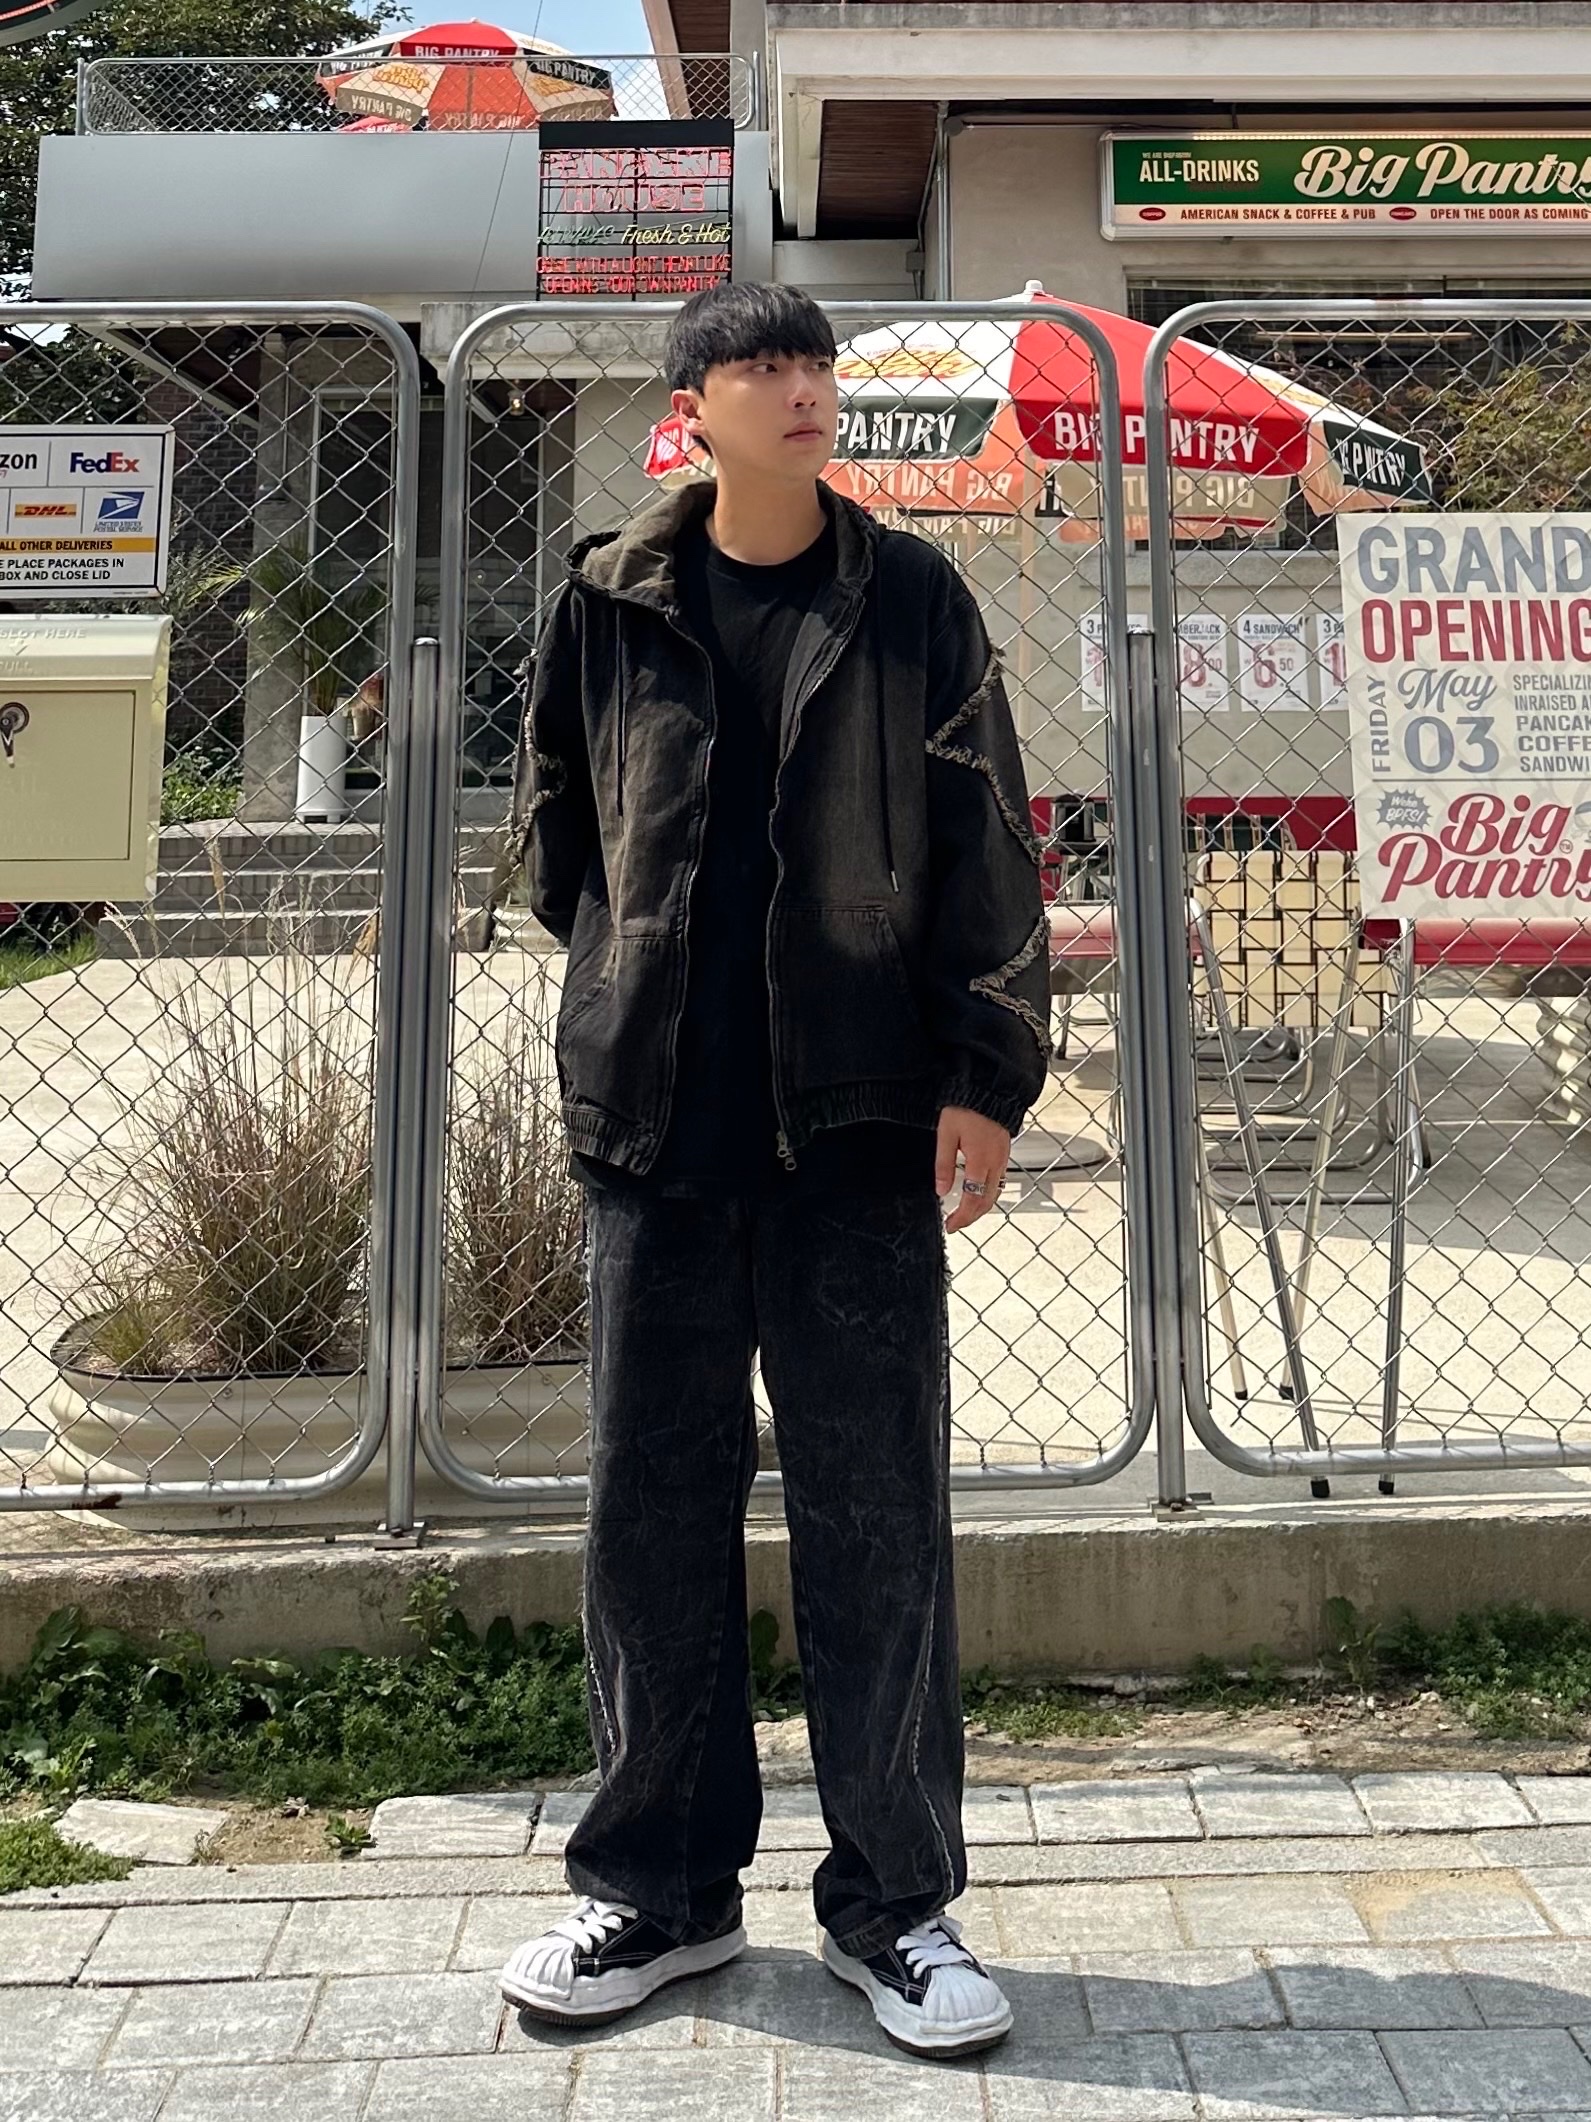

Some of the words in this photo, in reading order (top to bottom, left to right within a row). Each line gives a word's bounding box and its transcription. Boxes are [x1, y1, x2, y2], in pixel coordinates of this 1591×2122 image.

[1139, 159, 1260, 183] ALL-DRINKS
[1293, 144, 1411, 199] Big
[564, 180, 706, 213] HOUSE
[1180, 208, 1239, 220] AMERICAN
[1242, 208, 1280, 220] SNACK
[1283, 208, 1292, 220] &
[1295, 208, 1338, 220] COFFEE
[1341, 208, 1350, 220] &
[1353, 208, 1376, 220] PUB
[1430, 208, 1460, 219] OPEN
[1465, 208, 1485, 219] THE
[1489, 208, 1520, 219] DOOR
[1523, 208, 1539, 219] AS
[1542, 208, 1589, 219] COMING
[621, 224, 674, 244] Fresh
[677, 223, 693, 244] &
[695, 222, 732, 243] Hot
[836, 410, 957, 454] PANTRY
[1124, 414, 1259, 463] PNTRY
[69, 452, 140, 473] FedEx
[23, 506, 68, 516] DHL
[0, 541, 17, 551] ALL
[20, 540, 52, 551] OTHER
[55, 540, 113, 551] DELIVERIES
[8, 558, 45, 569] PLACE
[49, 558, 110, 569] PACKAGES
[112, 558, 124, 568] IN
[1357, 526, 1591, 594] GRAND
[24, 571, 49, 581] AND
[51, 570, 90, 581] CLOSE
[92, 570, 111, 580] LID
[45, 628, 87, 639] HERE
[1243, 619, 1251, 634] 4
[1323, 618, 1332, 633] 3
[1361, 598, 1591, 664] OPENING
[1397, 668, 1498, 713] May
[1514, 694, 1577, 711] INRAISED
[1366, 674, 1391, 773] FRIDAY
[1403, 715, 1500, 774] 03
[1440, 793, 1572, 857] Big
